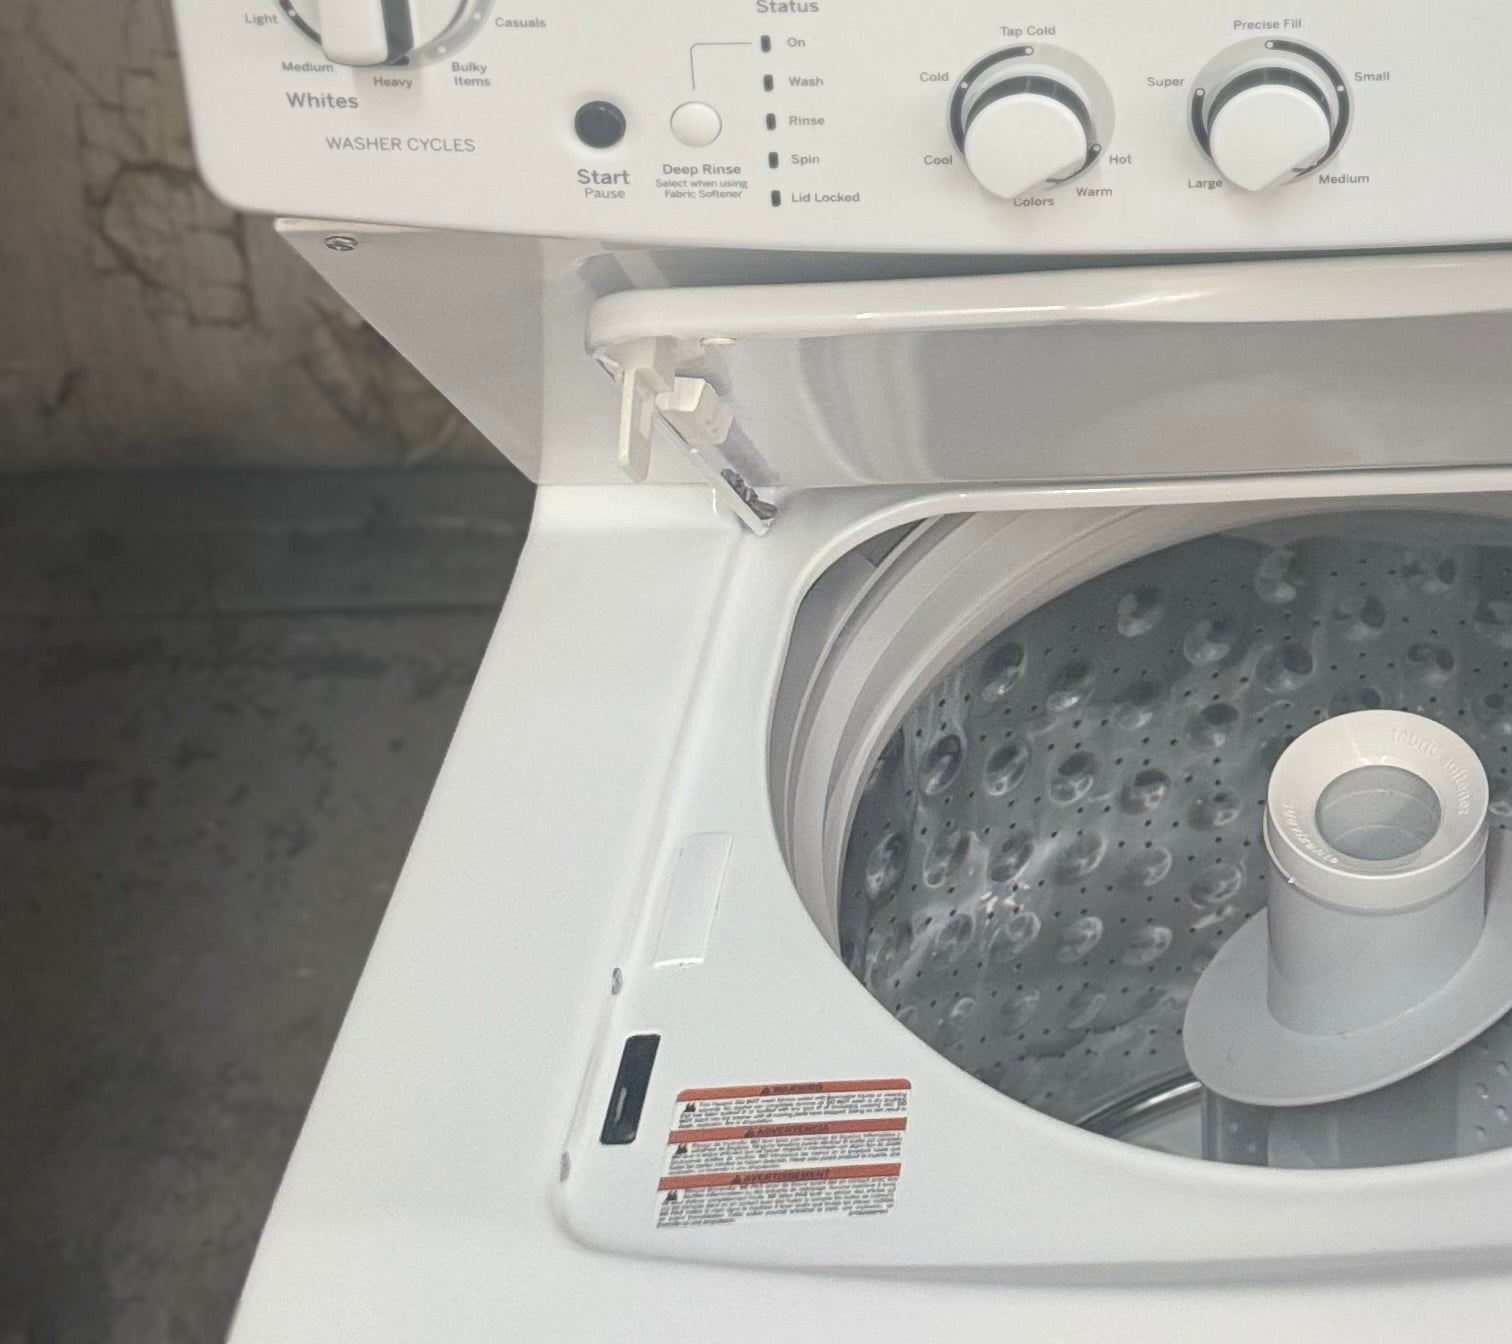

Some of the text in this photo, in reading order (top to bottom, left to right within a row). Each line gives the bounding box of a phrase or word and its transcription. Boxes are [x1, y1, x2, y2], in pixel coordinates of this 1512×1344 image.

[244, 12, 278, 26] Light
[495, 15, 547, 29] Casuals
[1233, 18, 1302, 30] Precise Fill
[1000, 25, 1056, 39] Tap Cold
[787, 37, 806, 48] On
[281, 61, 334, 73] Medium
[451, 61, 488, 74] Bulky
[373, 76, 413, 89] Heavy
[454, 75, 491, 87] Items
[788, 76, 824, 87] Wash
[919, 71, 949, 83] Cold
[1353, 71, 1390, 82] Small
[1147, 76, 1185, 90] Super
[286, 92, 359, 109] Whites
[789, 115, 825, 126] Rinse
[326, 136, 476, 153] WASHER CYCLES
[791, 154, 820, 166] Spin
[923, 154, 953, 166] Cool
[1108, 154, 1133, 165] Hot
[662, 164, 741, 176] Deep Rinse
[577, 168, 630, 185] Start
[1318, 173, 1370, 185] Medium
[655, 179, 748, 189] Select when using
[1187, 178, 1223, 191] Large
[584, 187, 625, 199] Pause
[665, 189, 742, 198] Fabric Softener
[791, 191, 861, 203] Lid Locked
[1075, 187, 1113, 198] Warm
[1013, 196, 1055, 208] Colors
